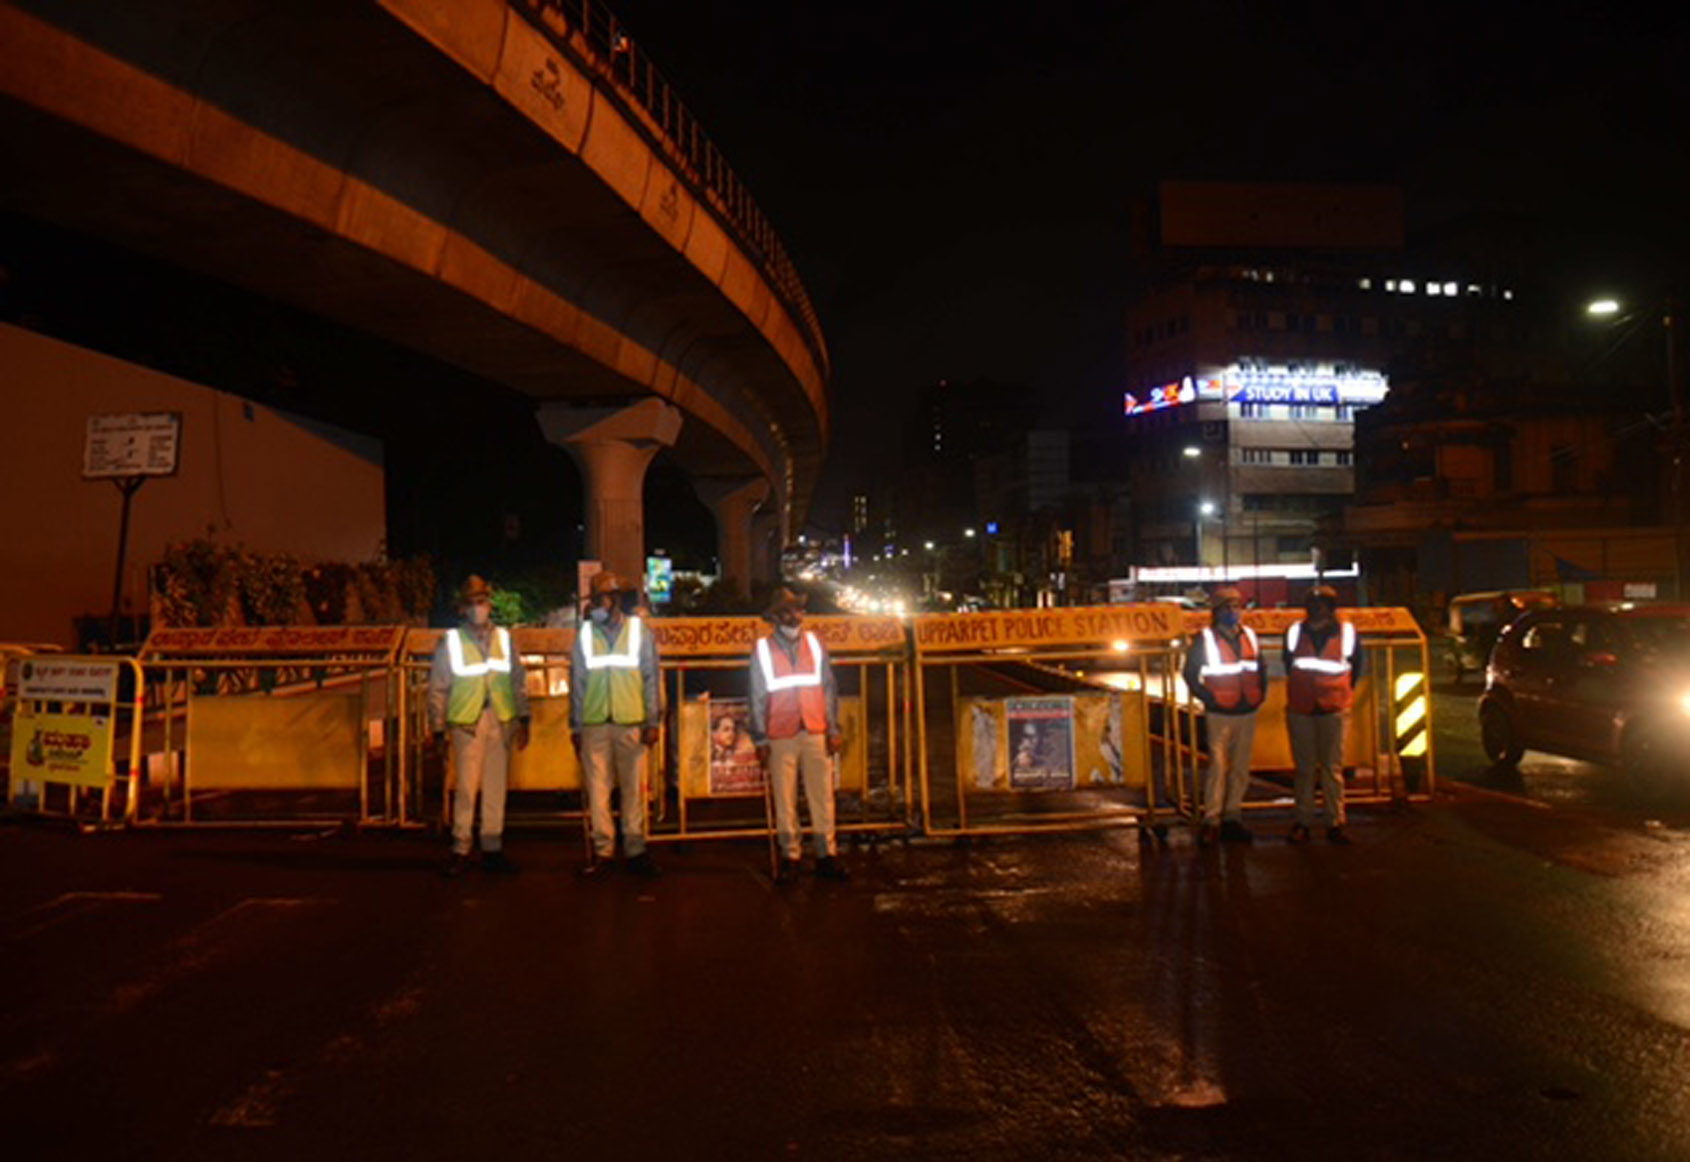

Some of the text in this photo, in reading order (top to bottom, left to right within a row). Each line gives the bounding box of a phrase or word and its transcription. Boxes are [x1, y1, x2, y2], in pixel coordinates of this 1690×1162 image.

[1245, 384, 1333, 401] STUDY IN UK
[917, 616, 998, 644] UPPARPET
[1002, 613, 1066, 640] POLICE
[1073, 610, 1170, 638] STATION
